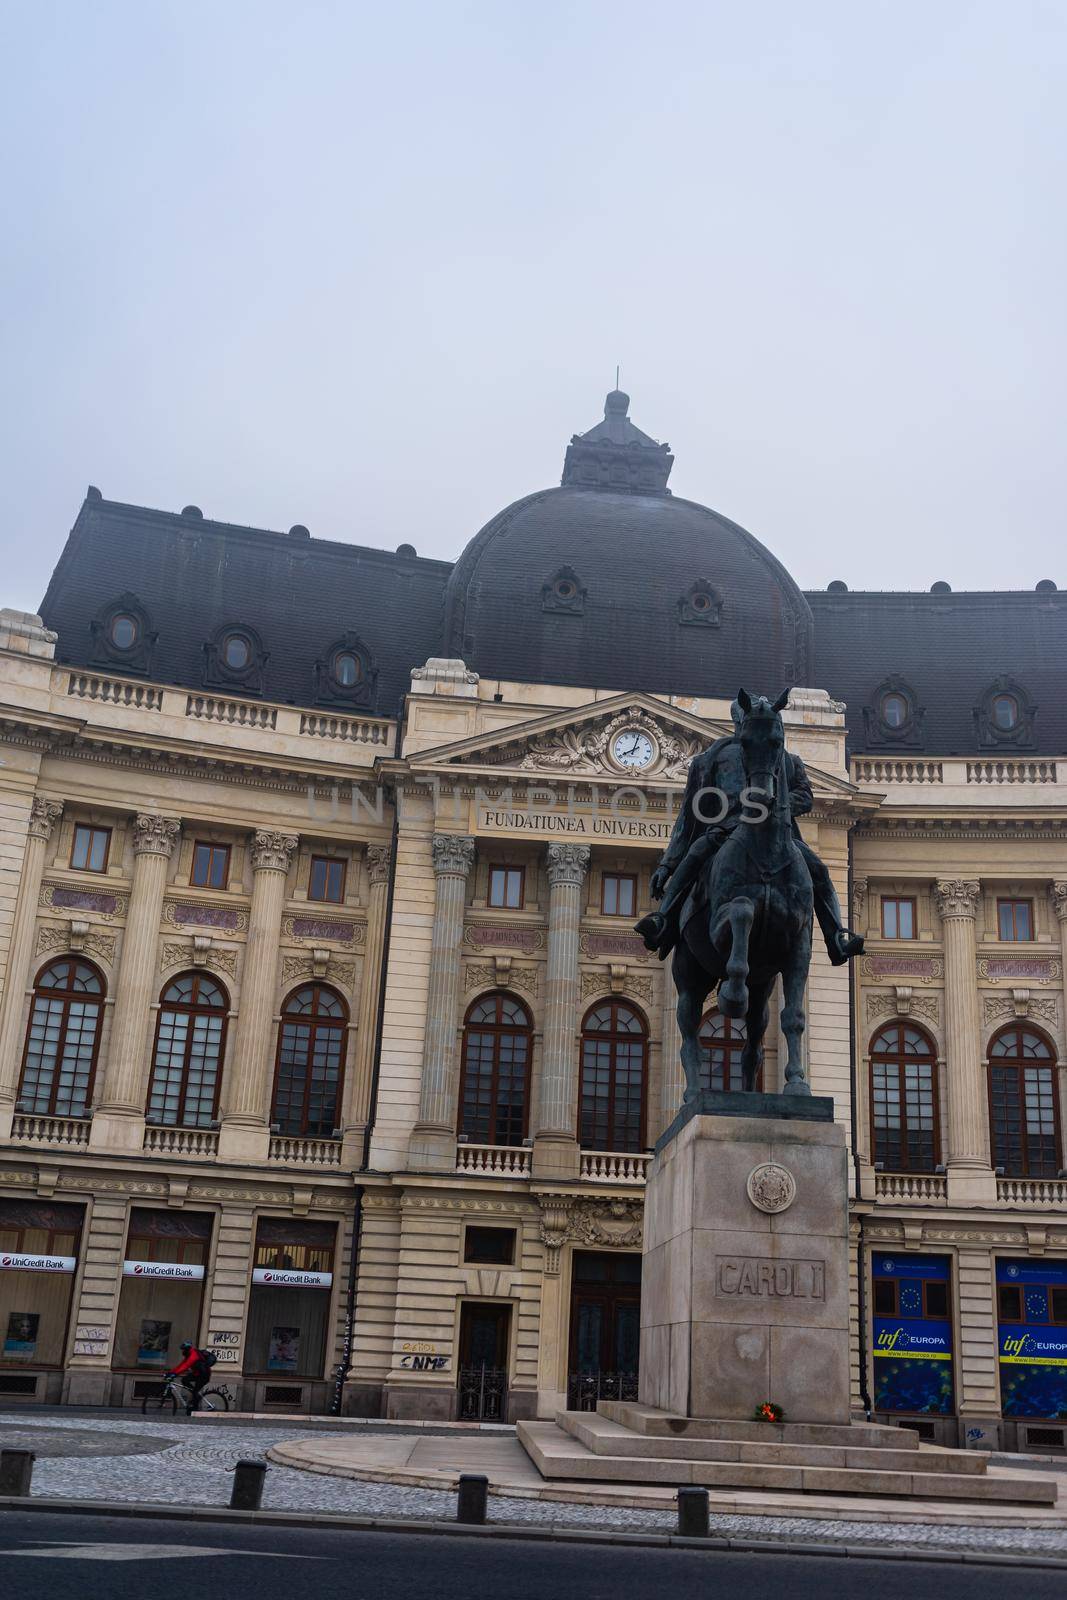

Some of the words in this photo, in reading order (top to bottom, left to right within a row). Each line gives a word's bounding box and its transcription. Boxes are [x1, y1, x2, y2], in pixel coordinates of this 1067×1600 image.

[485, 811, 586, 832] FUNDATIUNEA
[592, 819, 673, 838] UNIVERSIT
[12, 1257, 45, 1268] UniCredit
[45, 1260, 64, 1269] Bank
[143, 1266, 174, 1276] UniCredit
[175, 1267, 193, 1277] Bank
[272, 1274, 303, 1284] UniCredit
[303, 1275, 321, 1284] Bank
[720, 1262, 807, 1298] CAROL
[910, 1336, 945, 1344] EUROPA
